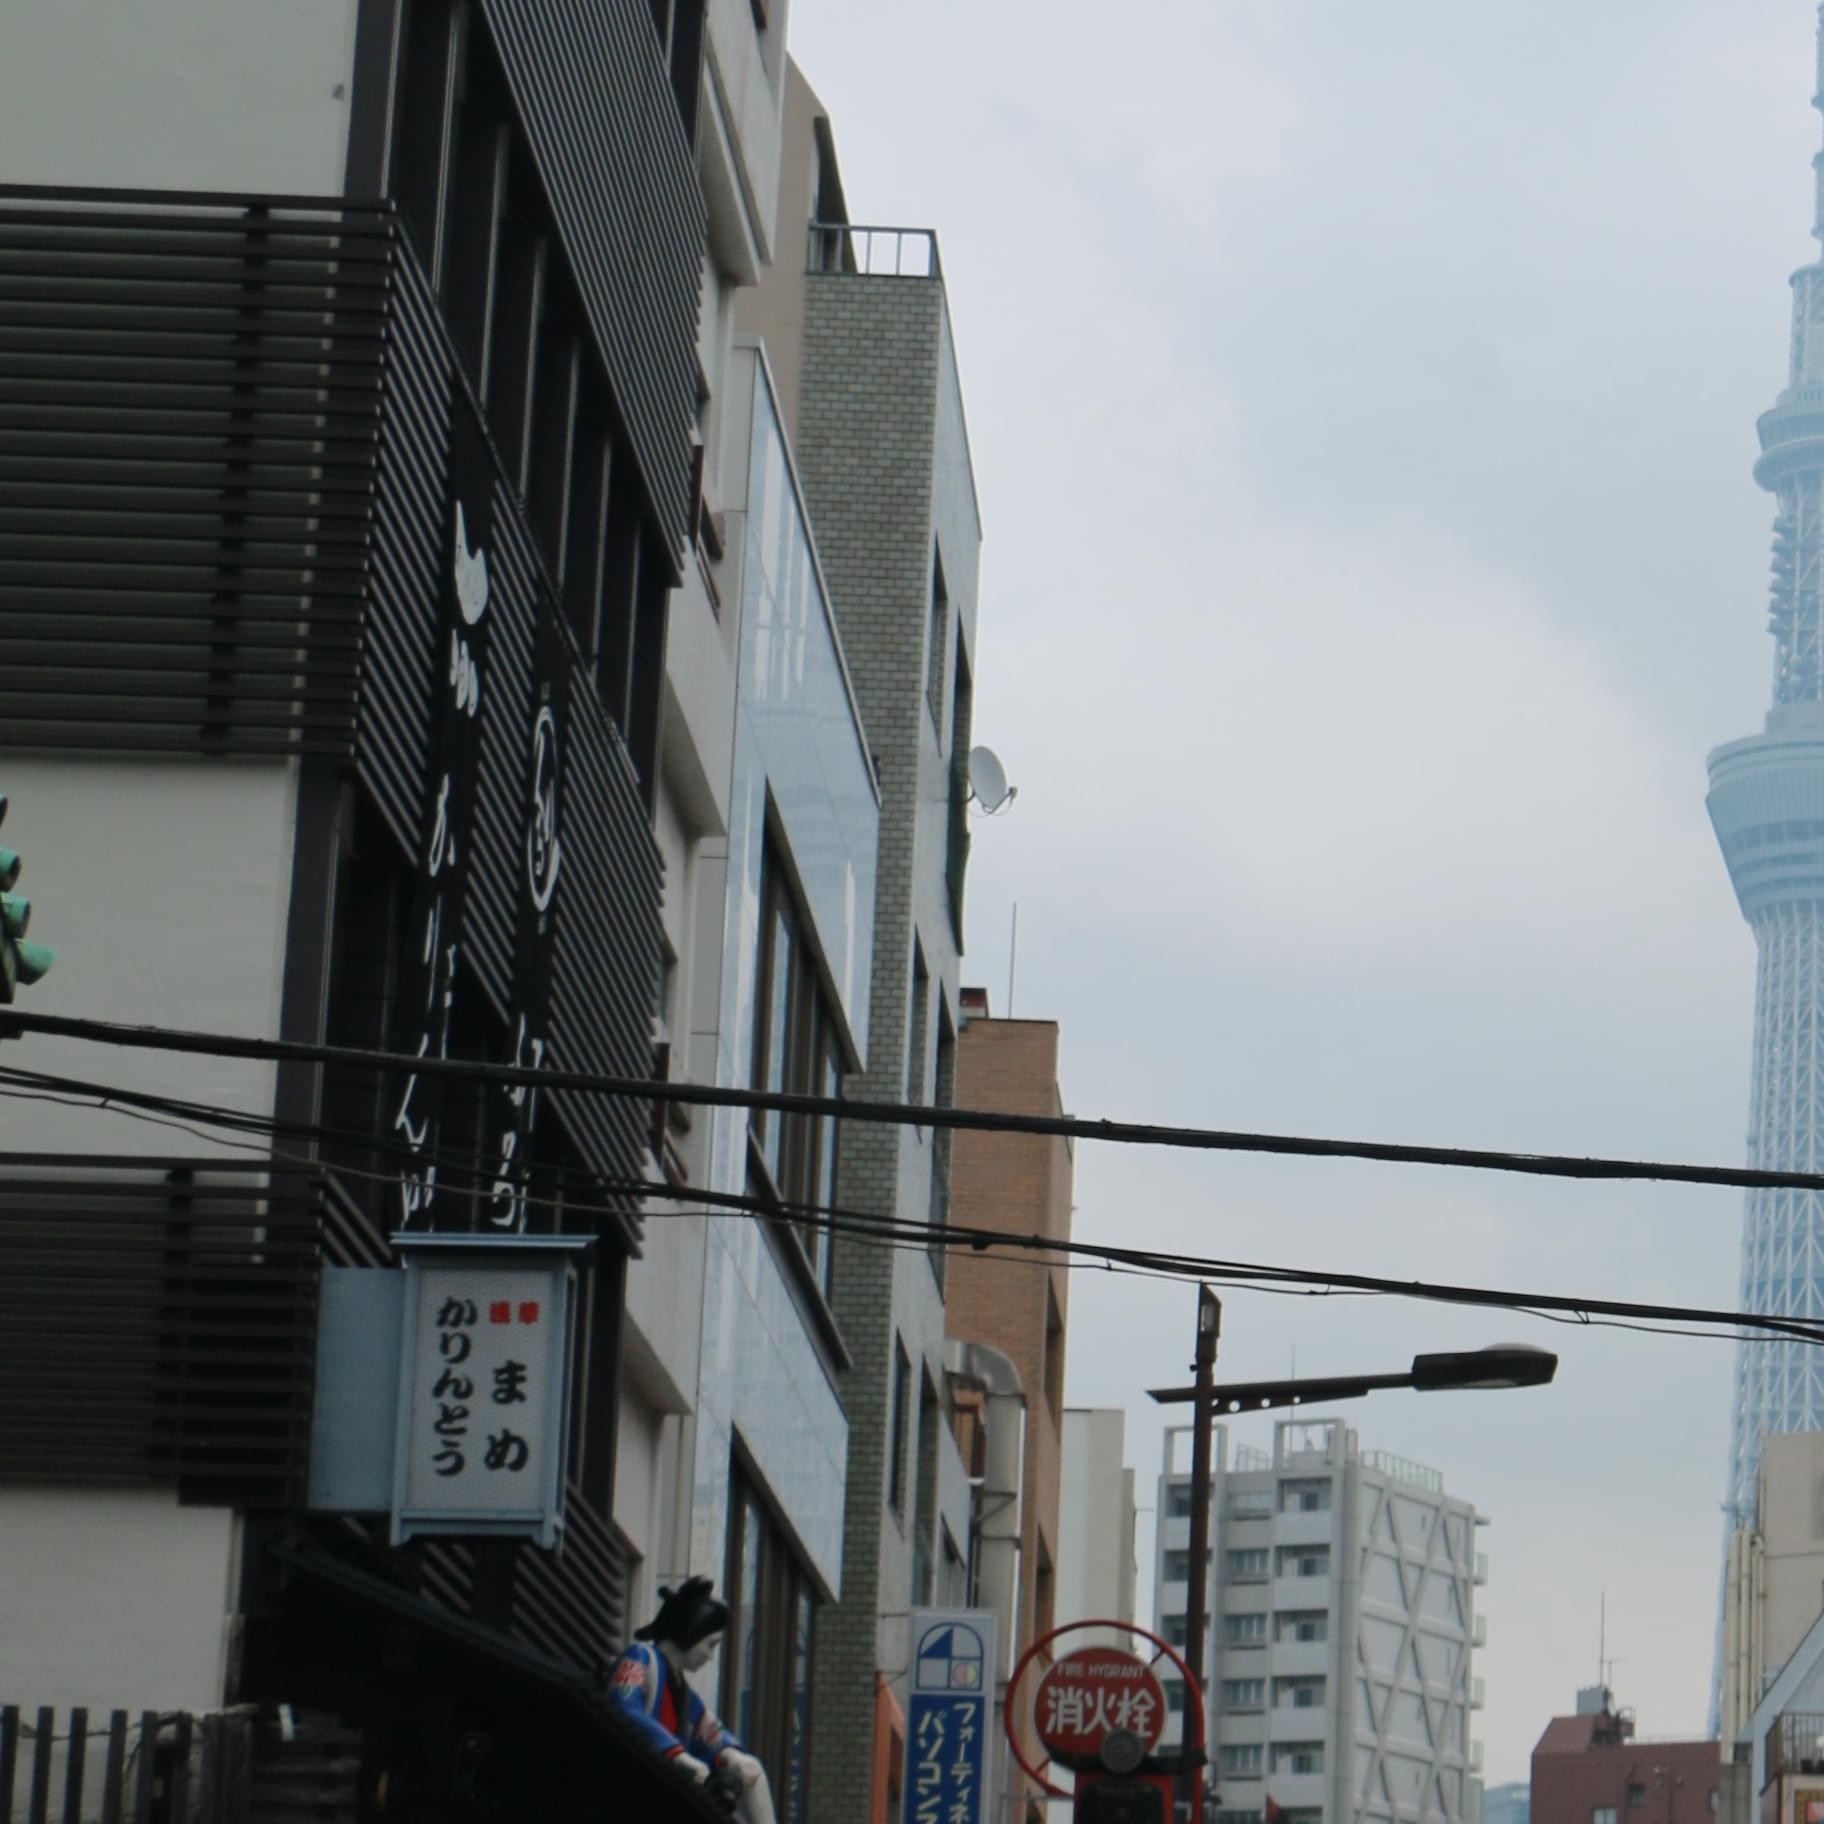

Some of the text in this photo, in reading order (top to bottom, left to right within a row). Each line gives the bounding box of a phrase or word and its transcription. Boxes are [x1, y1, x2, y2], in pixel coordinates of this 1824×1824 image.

[432, 1295, 477, 1476] かりんとう
[484, 1359, 528, 1472] まめ
[1045, 1684, 1156, 1738] 消火栓
[1057, 1663, 1145, 1679] FIRE HYDRANT
